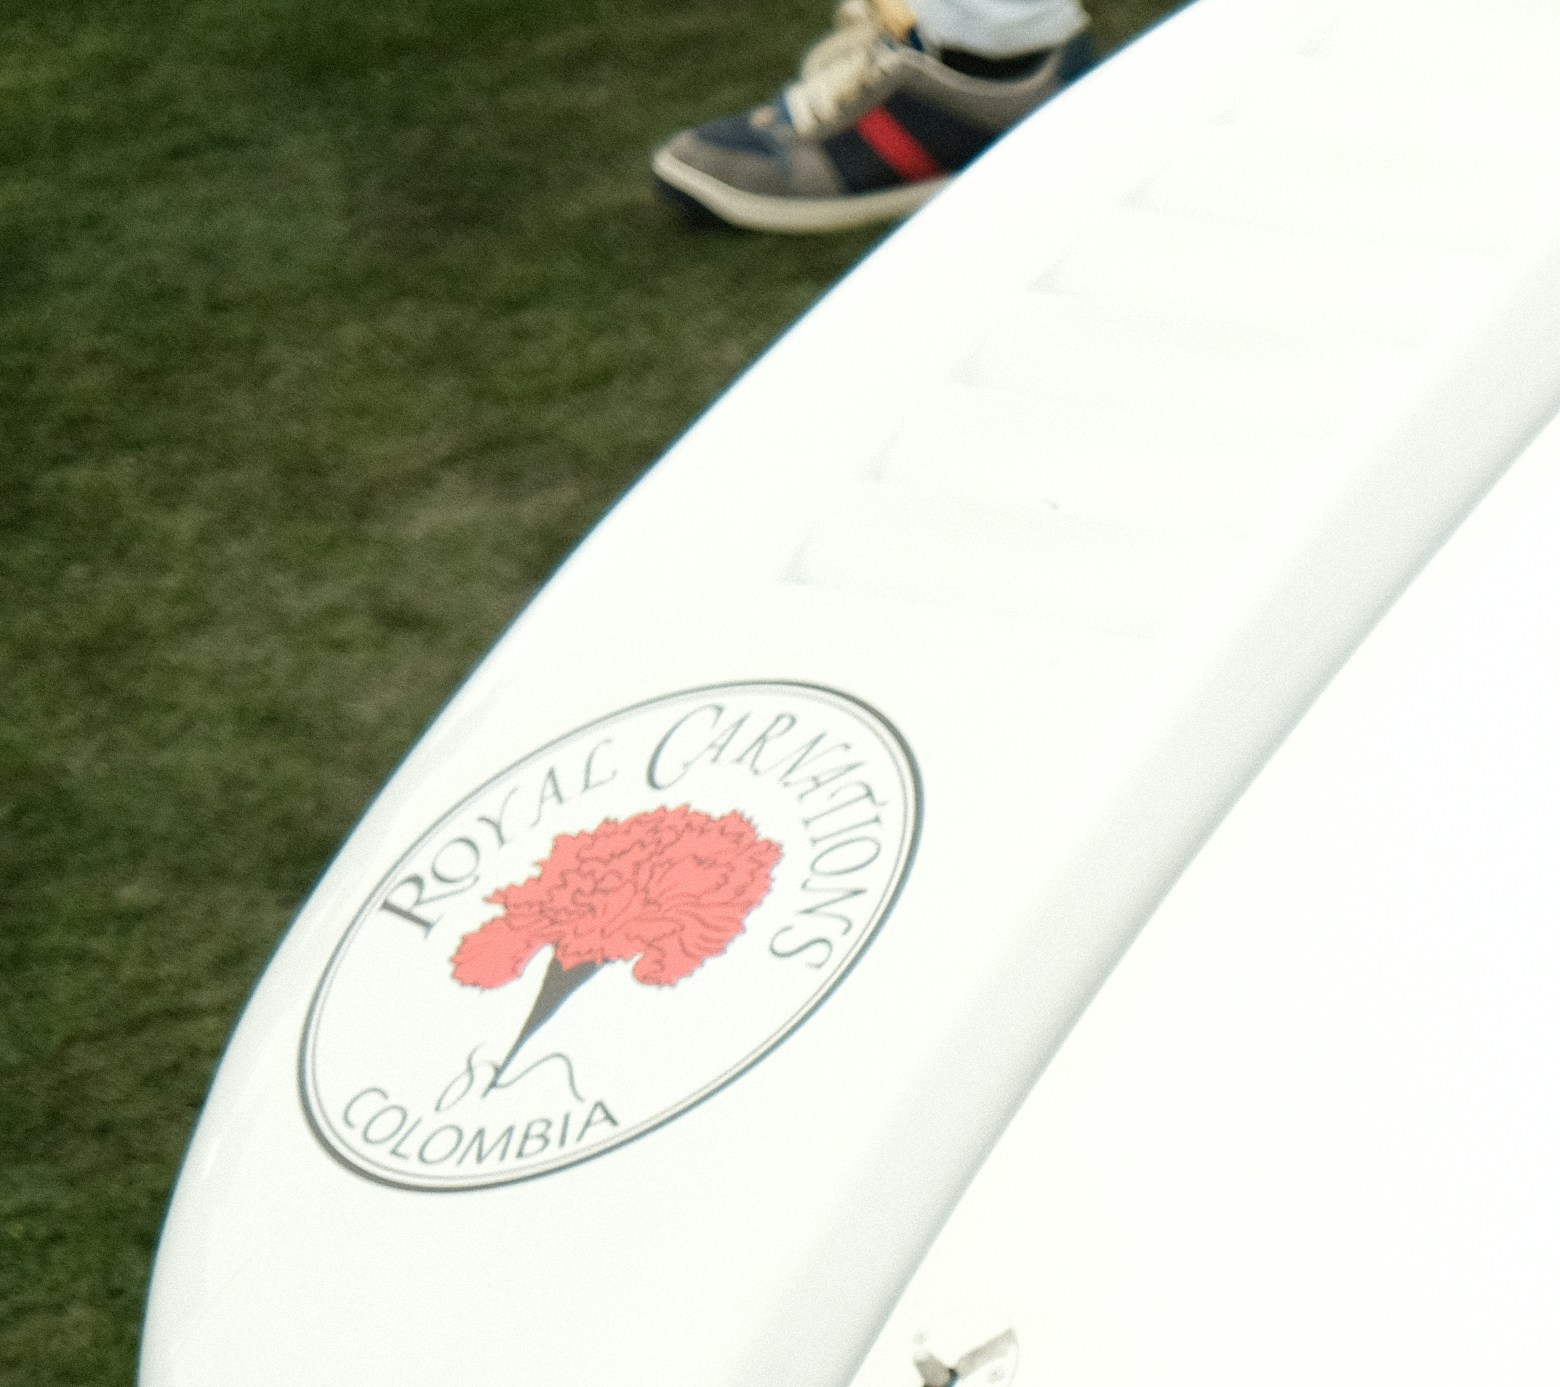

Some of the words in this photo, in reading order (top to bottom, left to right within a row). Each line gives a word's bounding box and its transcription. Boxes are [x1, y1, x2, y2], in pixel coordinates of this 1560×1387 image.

[379, 738, 619, 940] ROYAL
[645, 703, 890, 970] CARNATIONS
[343, 1087, 621, 1167] COLOMBIA
